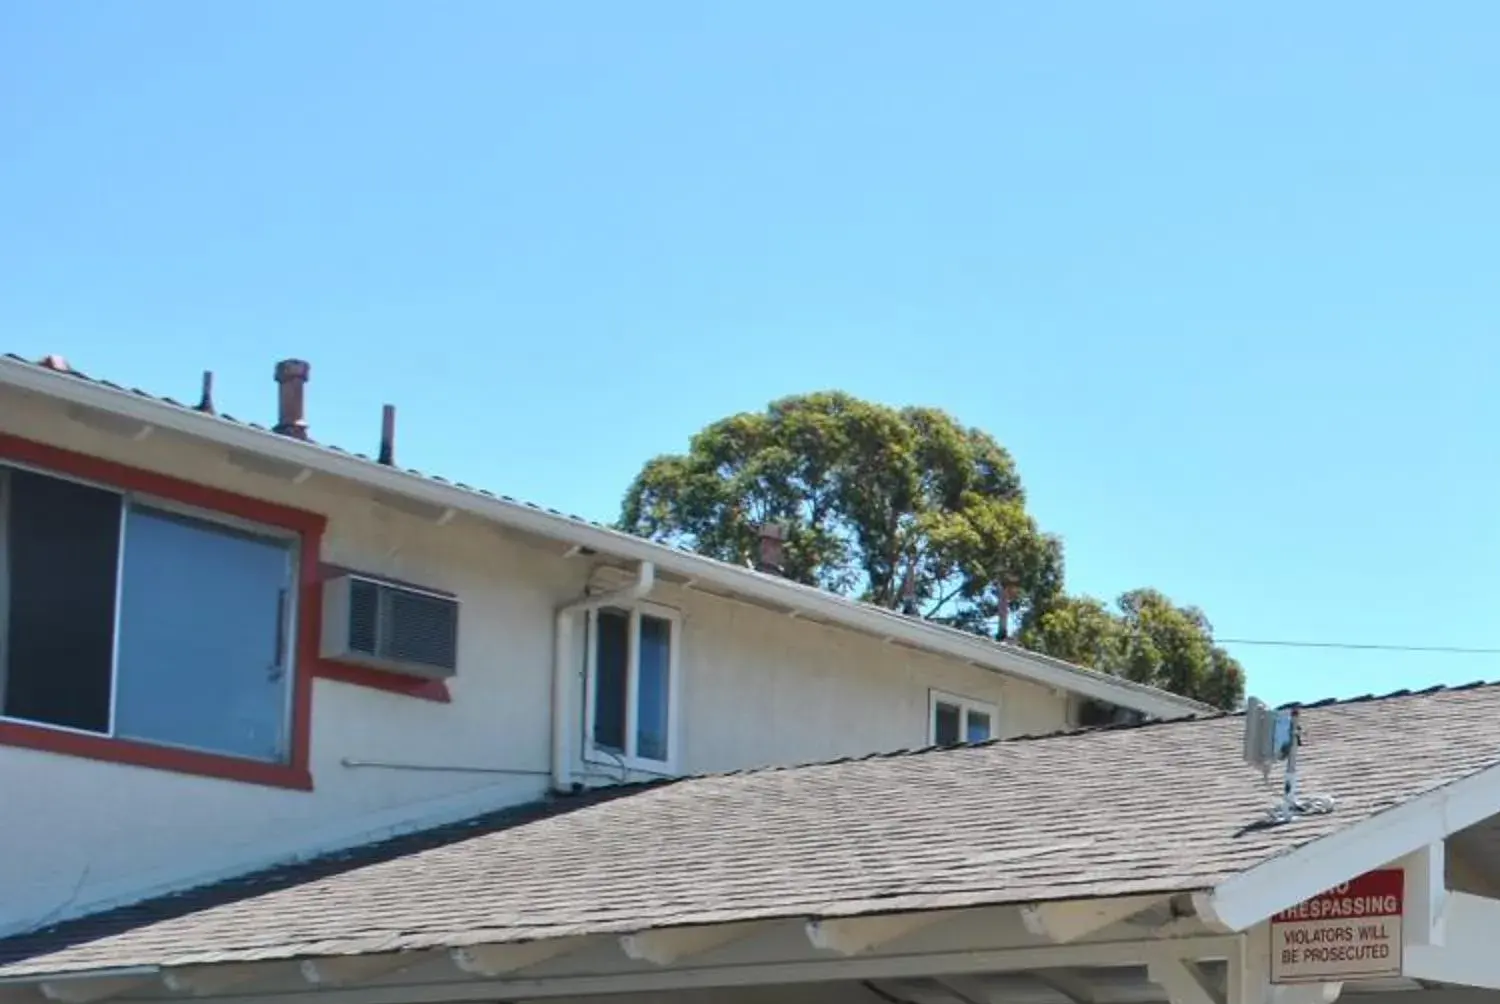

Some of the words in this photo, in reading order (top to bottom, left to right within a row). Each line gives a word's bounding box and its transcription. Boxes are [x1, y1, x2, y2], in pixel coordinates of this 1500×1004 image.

[1283, 927, 1353, 944] VIOLATORS
[1357, 925, 1389, 940] WILL
[1281, 949, 1299, 963] BE
[1303, 944, 1389, 962] PROSECUTED
